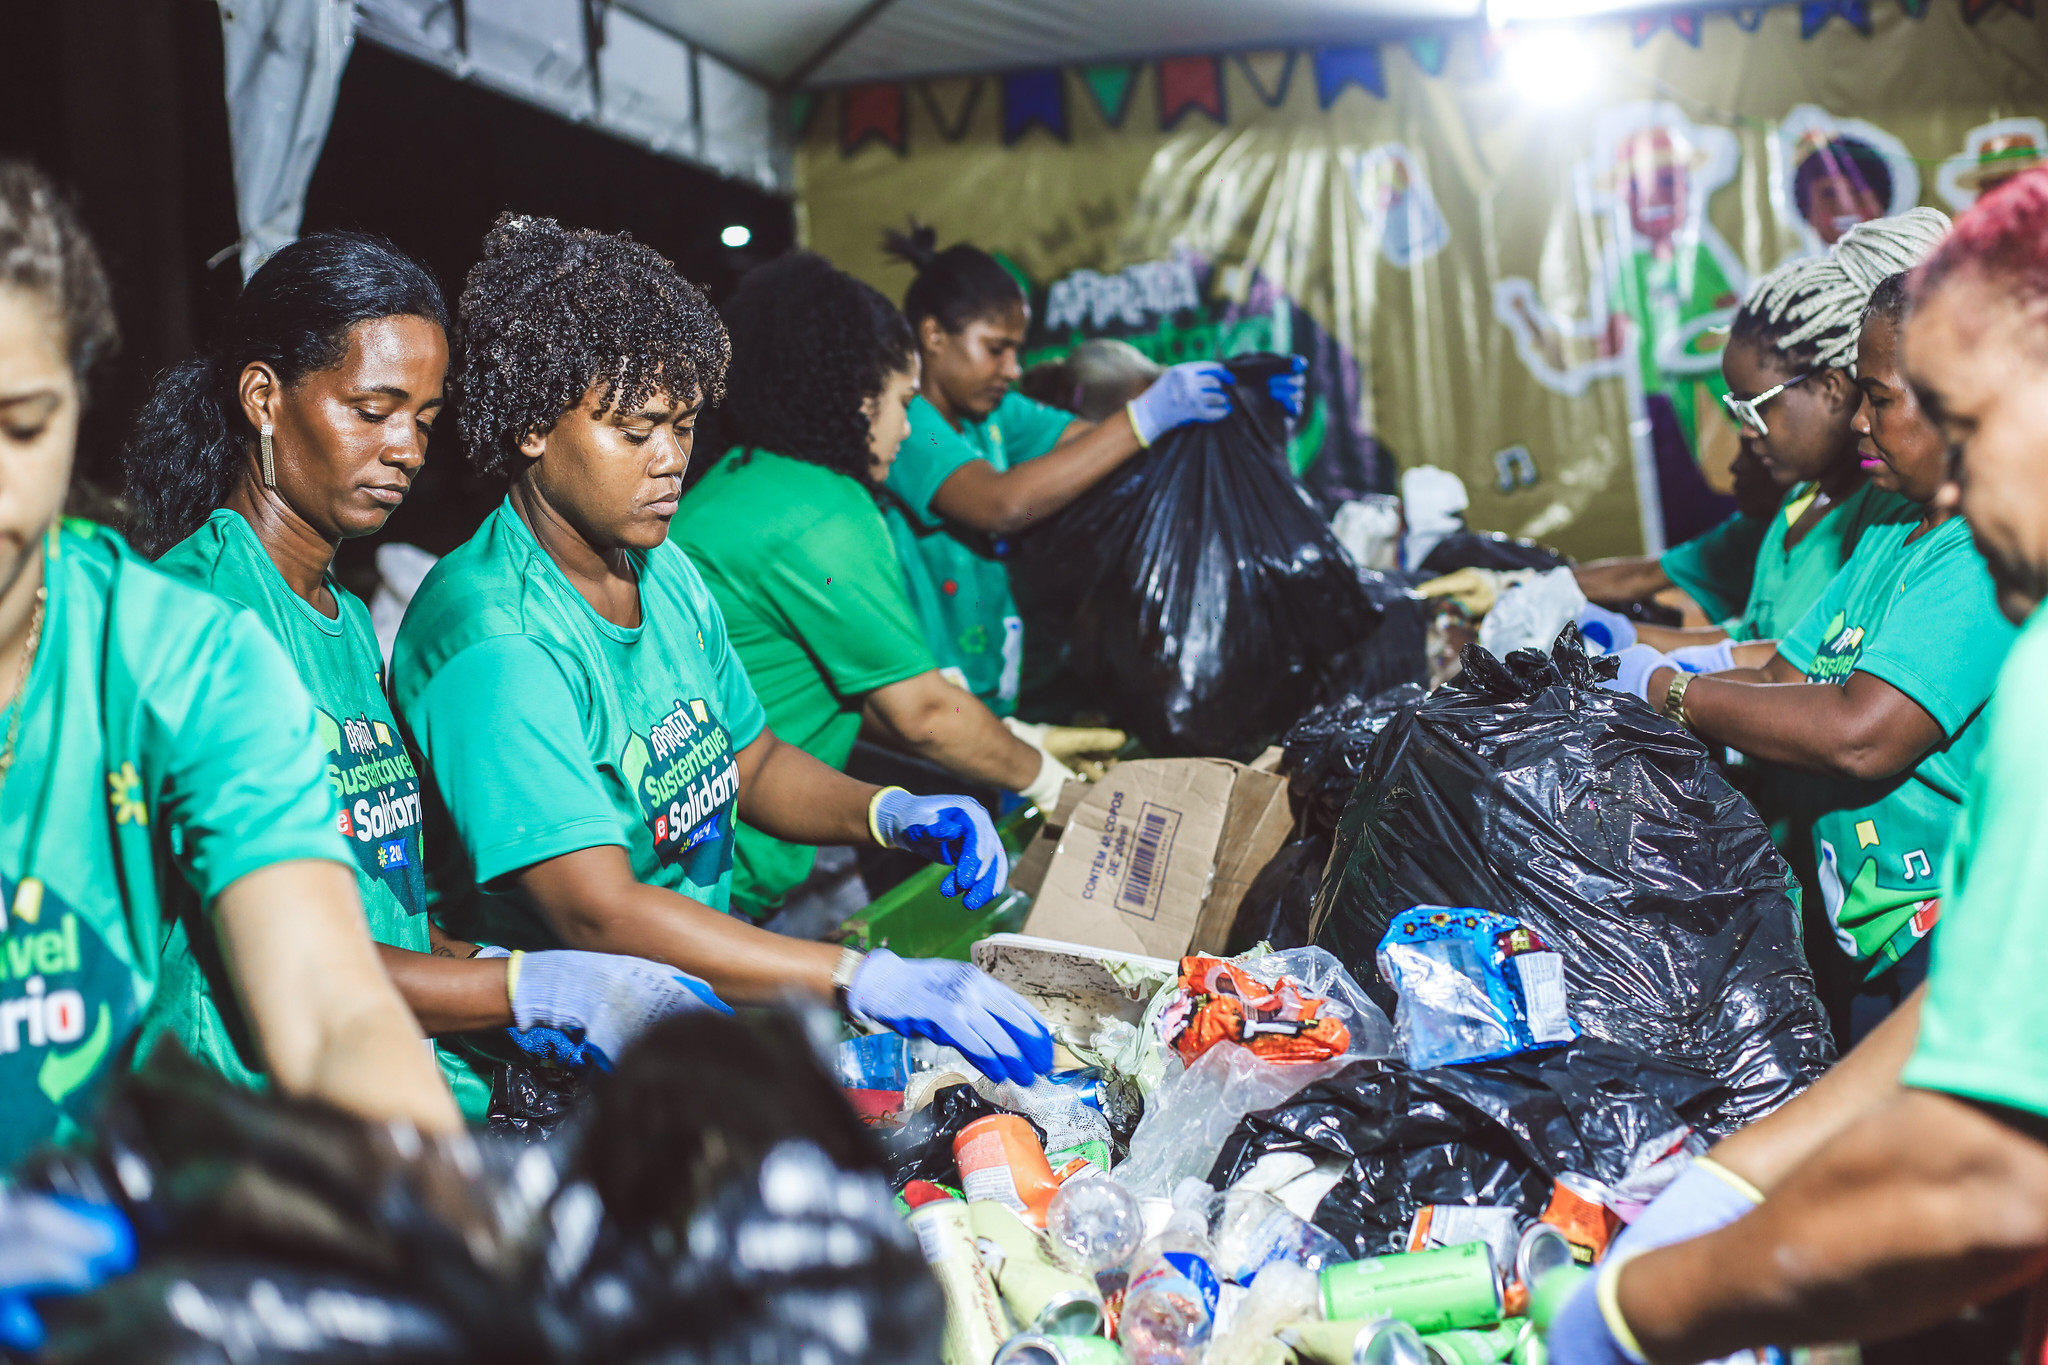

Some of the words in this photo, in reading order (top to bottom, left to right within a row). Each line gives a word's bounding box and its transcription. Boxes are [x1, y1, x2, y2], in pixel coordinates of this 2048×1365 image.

[644, 728, 728, 808] Sustentáve
[336, 813, 349, 834] e
[1105, 791, 1124, 833] COPOS
[657, 820, 666, 838] e
[1107, 860, 1119, 876] DE
[0, 913, 80, 980] vel
